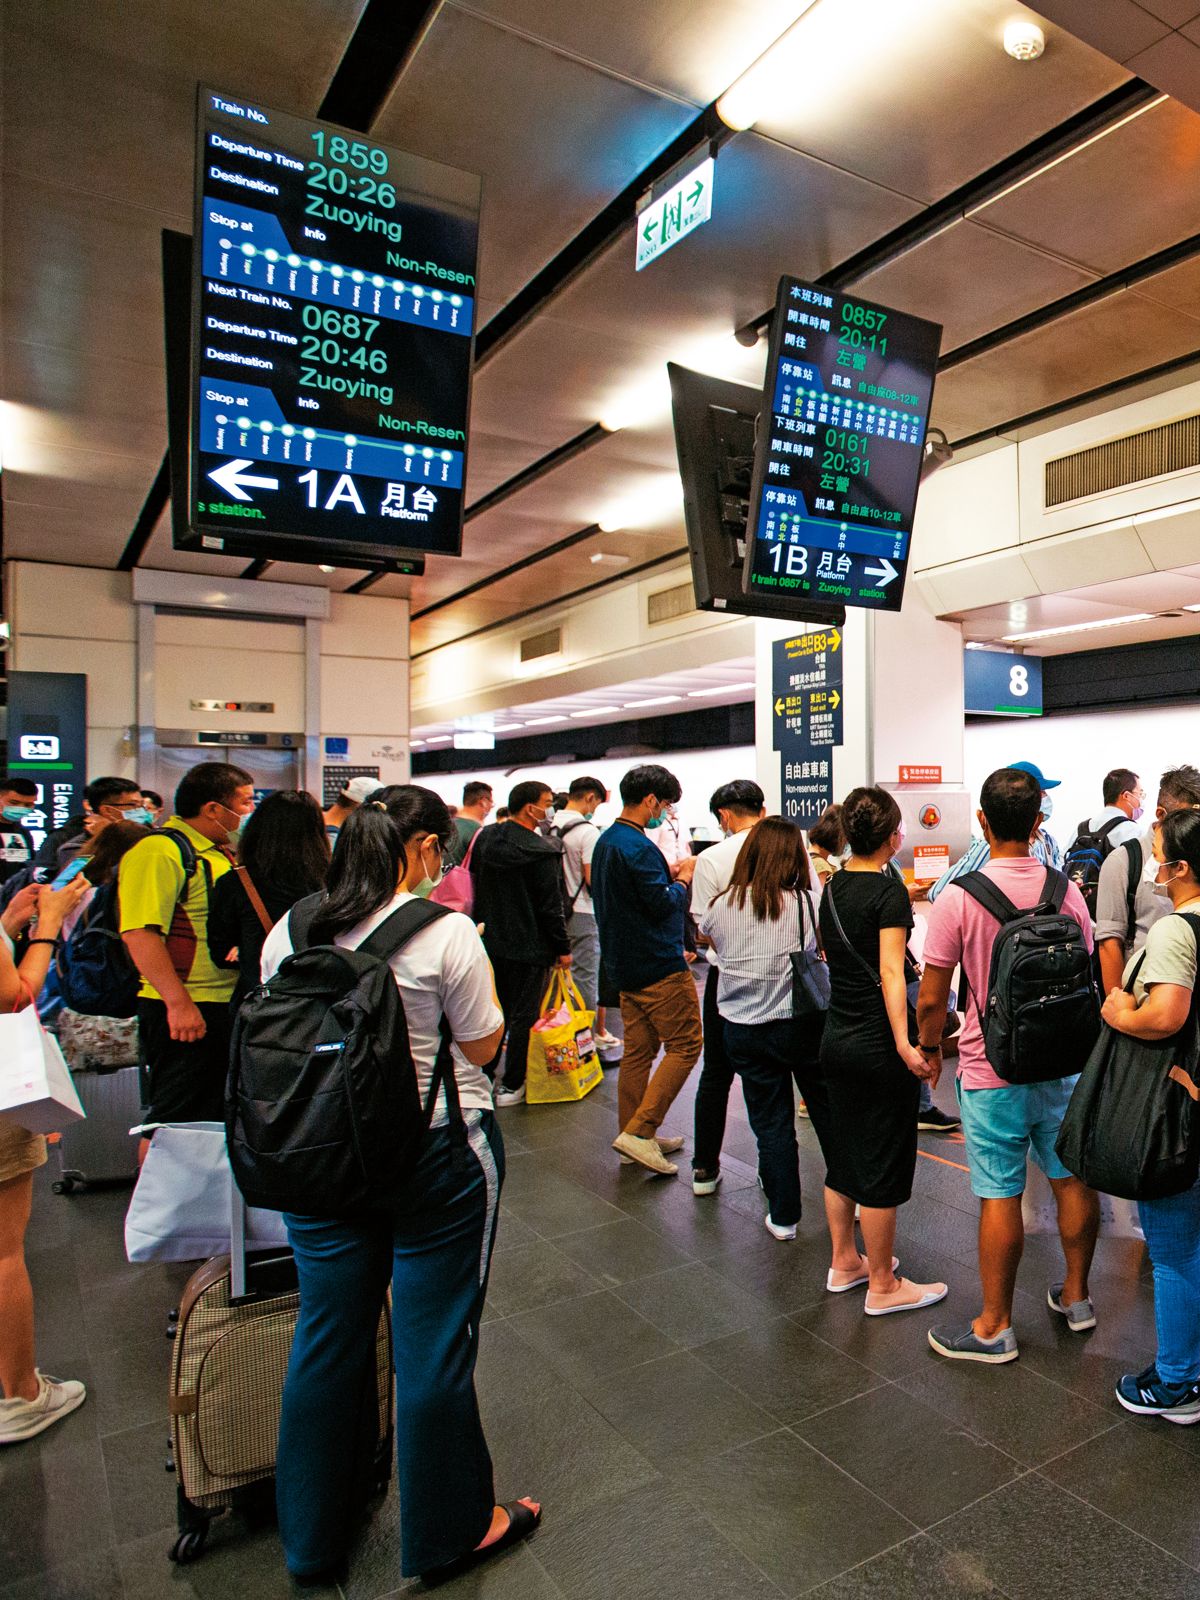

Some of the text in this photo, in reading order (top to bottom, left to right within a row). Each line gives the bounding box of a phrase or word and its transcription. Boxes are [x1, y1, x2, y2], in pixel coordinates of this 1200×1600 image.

[211, 96, 269, 124] Train No.
[211, 134, 304, 172] Departure Time
[311, 130, 389, 176] 1859
[210, 166, 279, 196] Destination
[306, 161, 396, 209] 20:26
[209, 211, 254, 233] Stop at
[305, 194, 401, 242] Zuoying
[304, 226, 326, 242] Info
[208, 282, 292, 310] Next Train No.
[790, 285, 833, 309] 本班列車
[302, 304, 380, 343] 0687
[787, 309, 831, 333] 開車時間
[842, 303, 887, 332] 0857
[207, 316, 298, 345] Departure Time
[784, 333, 807, 349] 開往
[838, 326, 887, 356] 20:11
[206, 347, 273, 370] Destination
[301, 336, 388, 375] 20:46
[836, 349, 867, 371] 左營
[781, 362, 813, 381] 停靠站
[832, 374, 852, 389] 訊息
[299, 367, 394, 406] Zuoying
[206, 390, 249, 408] Stop at
[298, 397, 320, 410] Info
[794, 397, 803, 416] 台北
[775, 415, 816, 436] 下班列車
[771, 439, 814, 458] 開車時間
[825, 429, 868, 454] 0161
[768, 461, 791, 477] 開往
[821, 451, 871, 477] 20:31
[299, 469, 366, 514] 1A
[820, 473, 850, 493] 左營
[381, 482, 438, 512] 月台
[766, 490, 797, 506] 停靠站
[815, 497, 835, 511] 訊息
[209, 502, 267, 519] station.
[381, 506, 428, 521] Platform
[778, 523, 787, 541] 台北
[769, 543, 808, 575] 1B
[817, 551, 852, 573] 月台
[816, 569, 845, 580] Platform
[757, 575, 777, 586] train
[779, 577, 800, 588] 0857
[803, 580, 810, 590] is
[818, 582, 852, 596] Zuoying
[859, 588, 887, 599] station.
[814, 633, 827, 652] B3
[1009, 665, 1029, 696] 8
[785, 760, 829, 779] 自由座車廂
[785, 783, 828, 793] Non-reserved car
